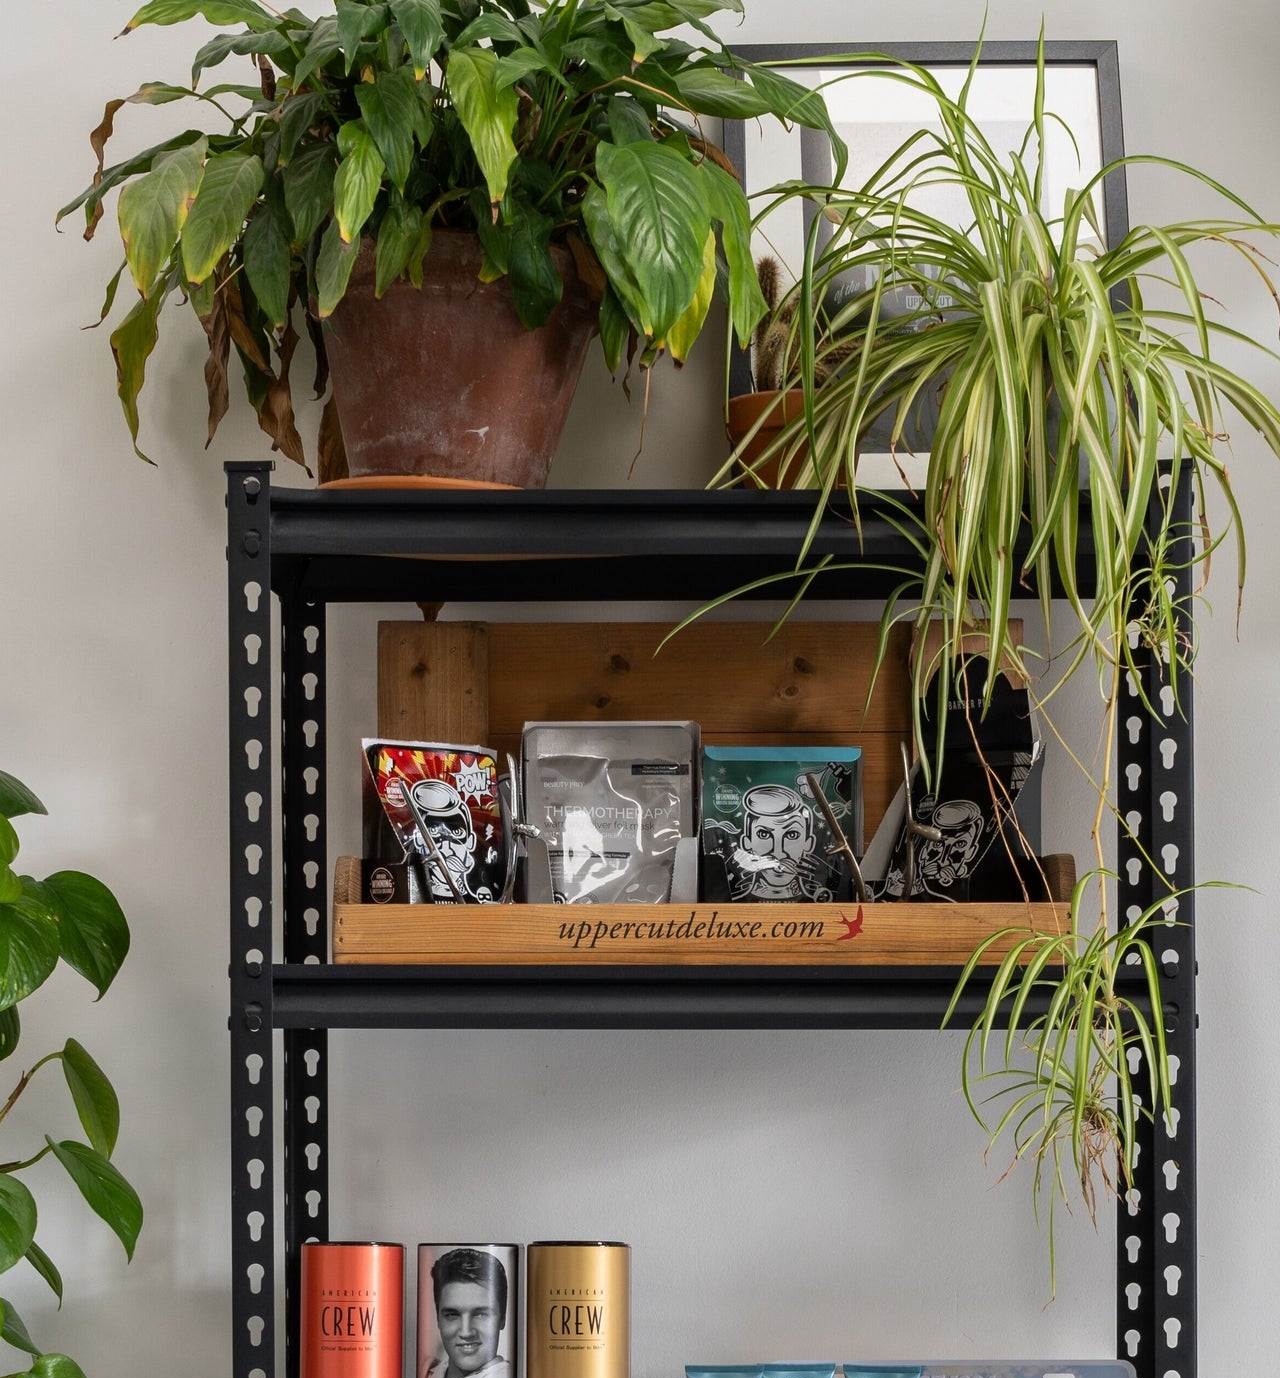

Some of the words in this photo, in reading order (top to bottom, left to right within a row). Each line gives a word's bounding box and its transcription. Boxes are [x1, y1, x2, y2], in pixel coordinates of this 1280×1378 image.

[845, 281, 860, 296] the
[455, 767, 491, 793] POW!
[559, 911, 825, 948] uppercutdeluxe.com
